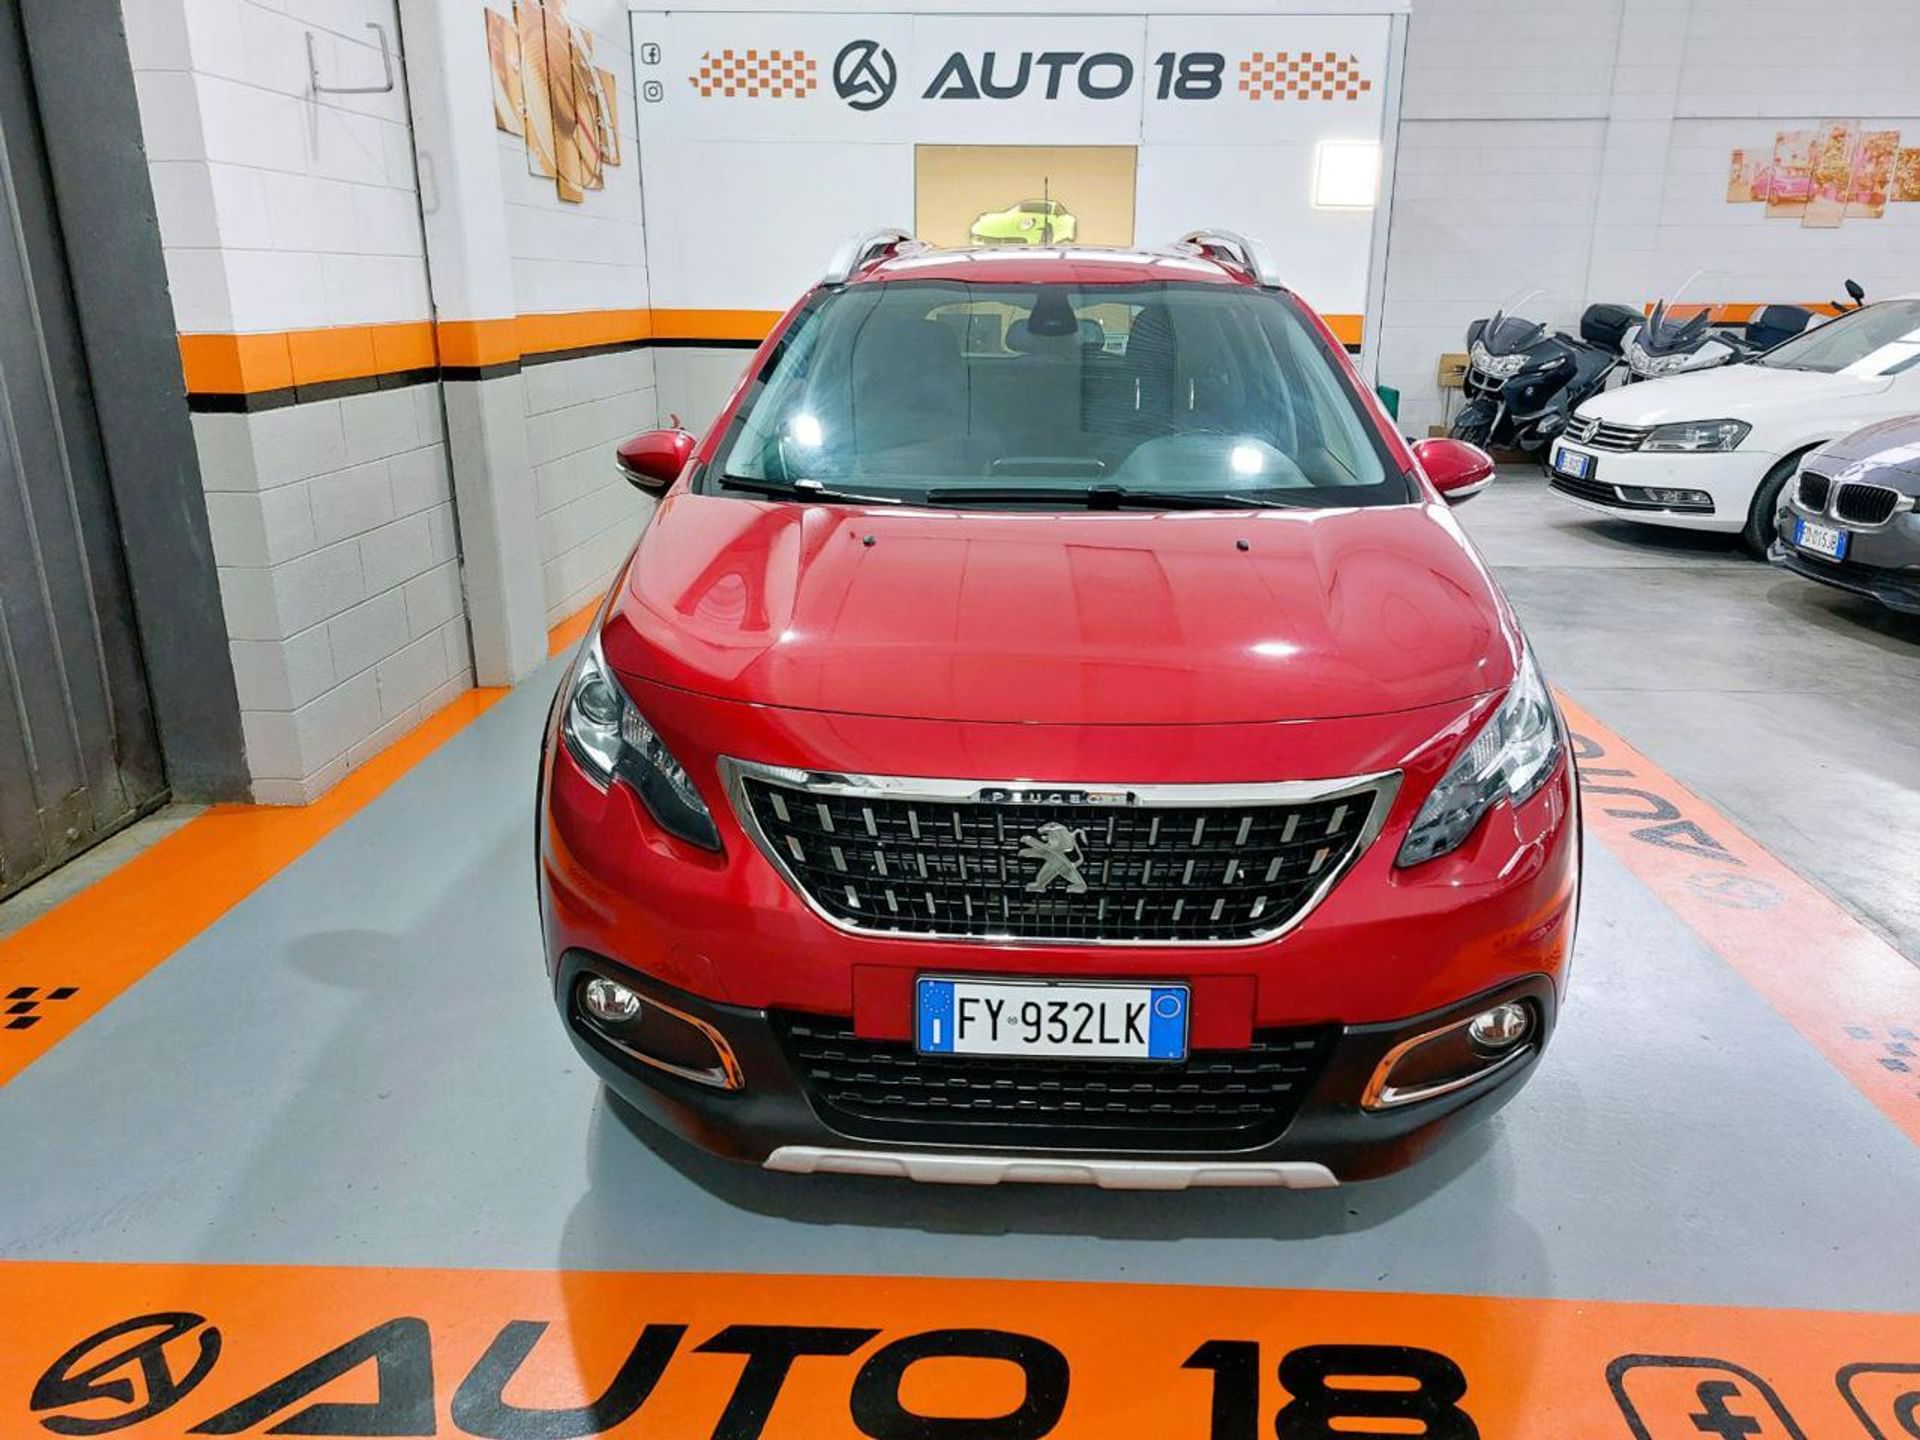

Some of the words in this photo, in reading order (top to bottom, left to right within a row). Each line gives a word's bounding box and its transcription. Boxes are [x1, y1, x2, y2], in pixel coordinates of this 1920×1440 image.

[923, 52, 1133, 100] AUTO
[1156, 52, 1225, 100] 18
[991, 790, 1122, 804] PEUGEO
[185, 1316, 1070, 1440] AUTO
[1181, 1340, 1482, 1440] 18
